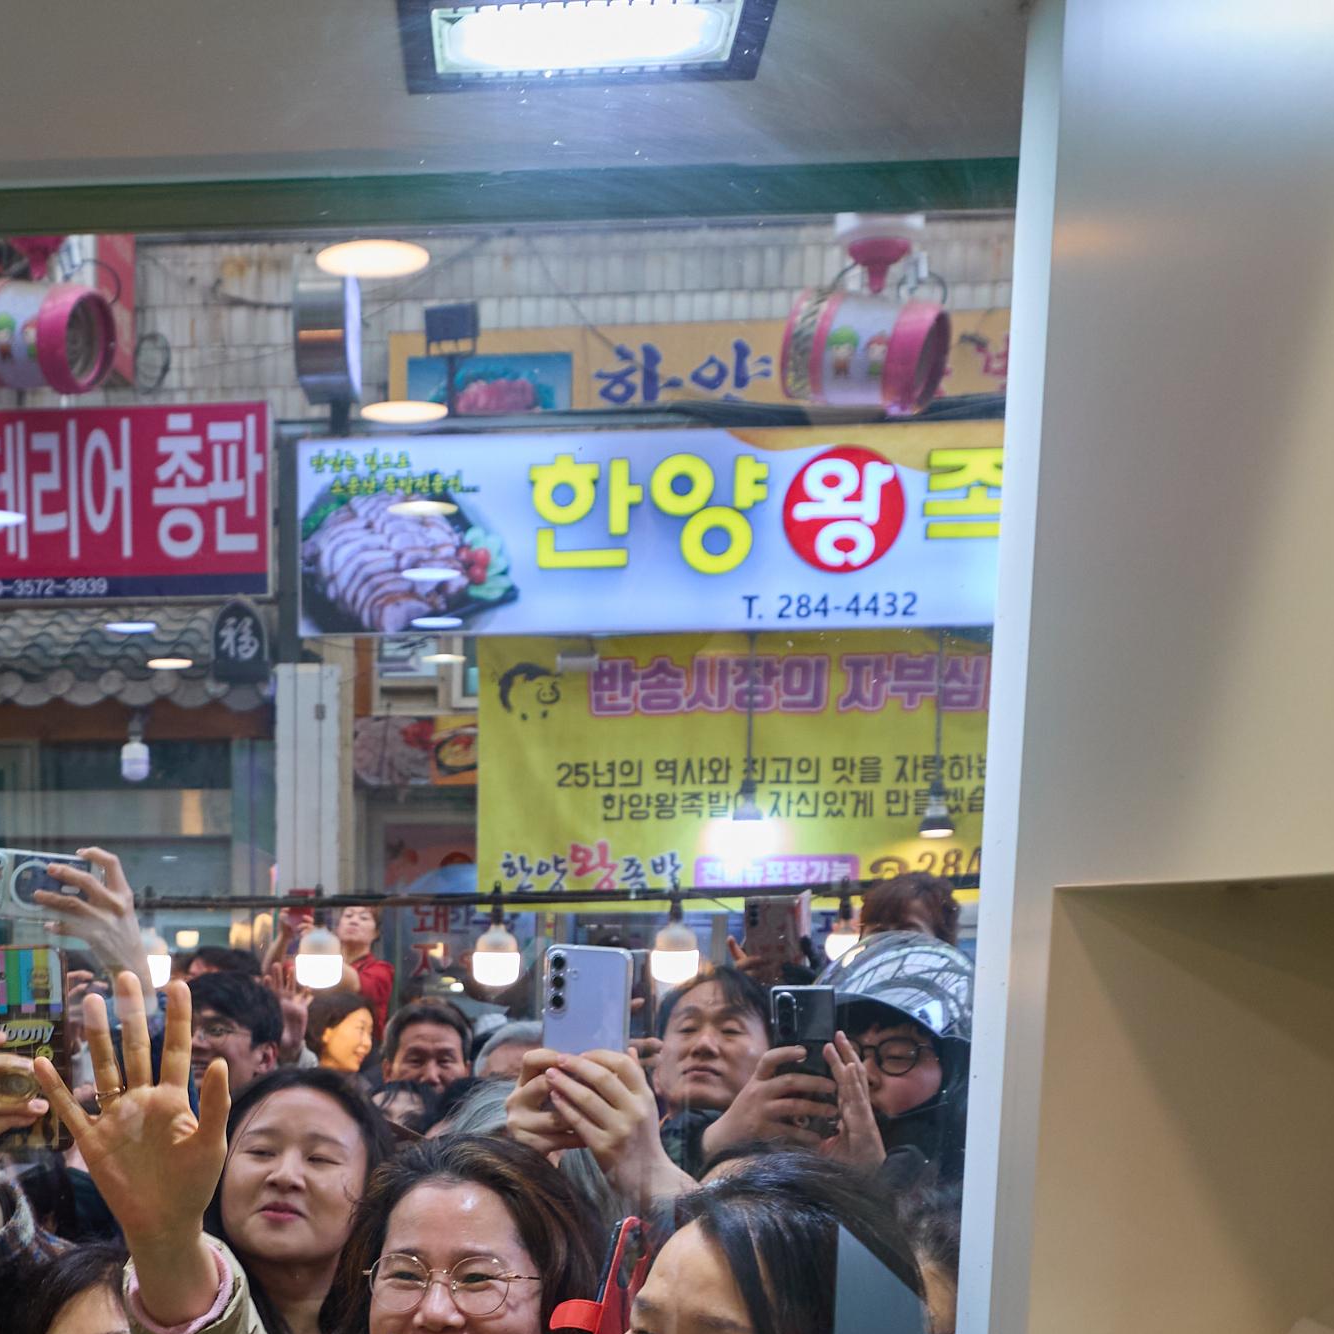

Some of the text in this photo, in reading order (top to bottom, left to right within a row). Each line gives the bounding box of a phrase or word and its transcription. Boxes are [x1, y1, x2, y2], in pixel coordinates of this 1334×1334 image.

[151, 413, 264, 560] 총판
[776, 592, 918, 620] 284-4432
[589, 653, 830, 716] 반송시장의
[556, 760, 643, 788] 25년의
[655, 758, 732, 786] 역사와
[833, 756, 882, 784] 맛을
[603, 790, 752, 821] 한양왕족발
[769, 789, 874, 819] 자신있게
